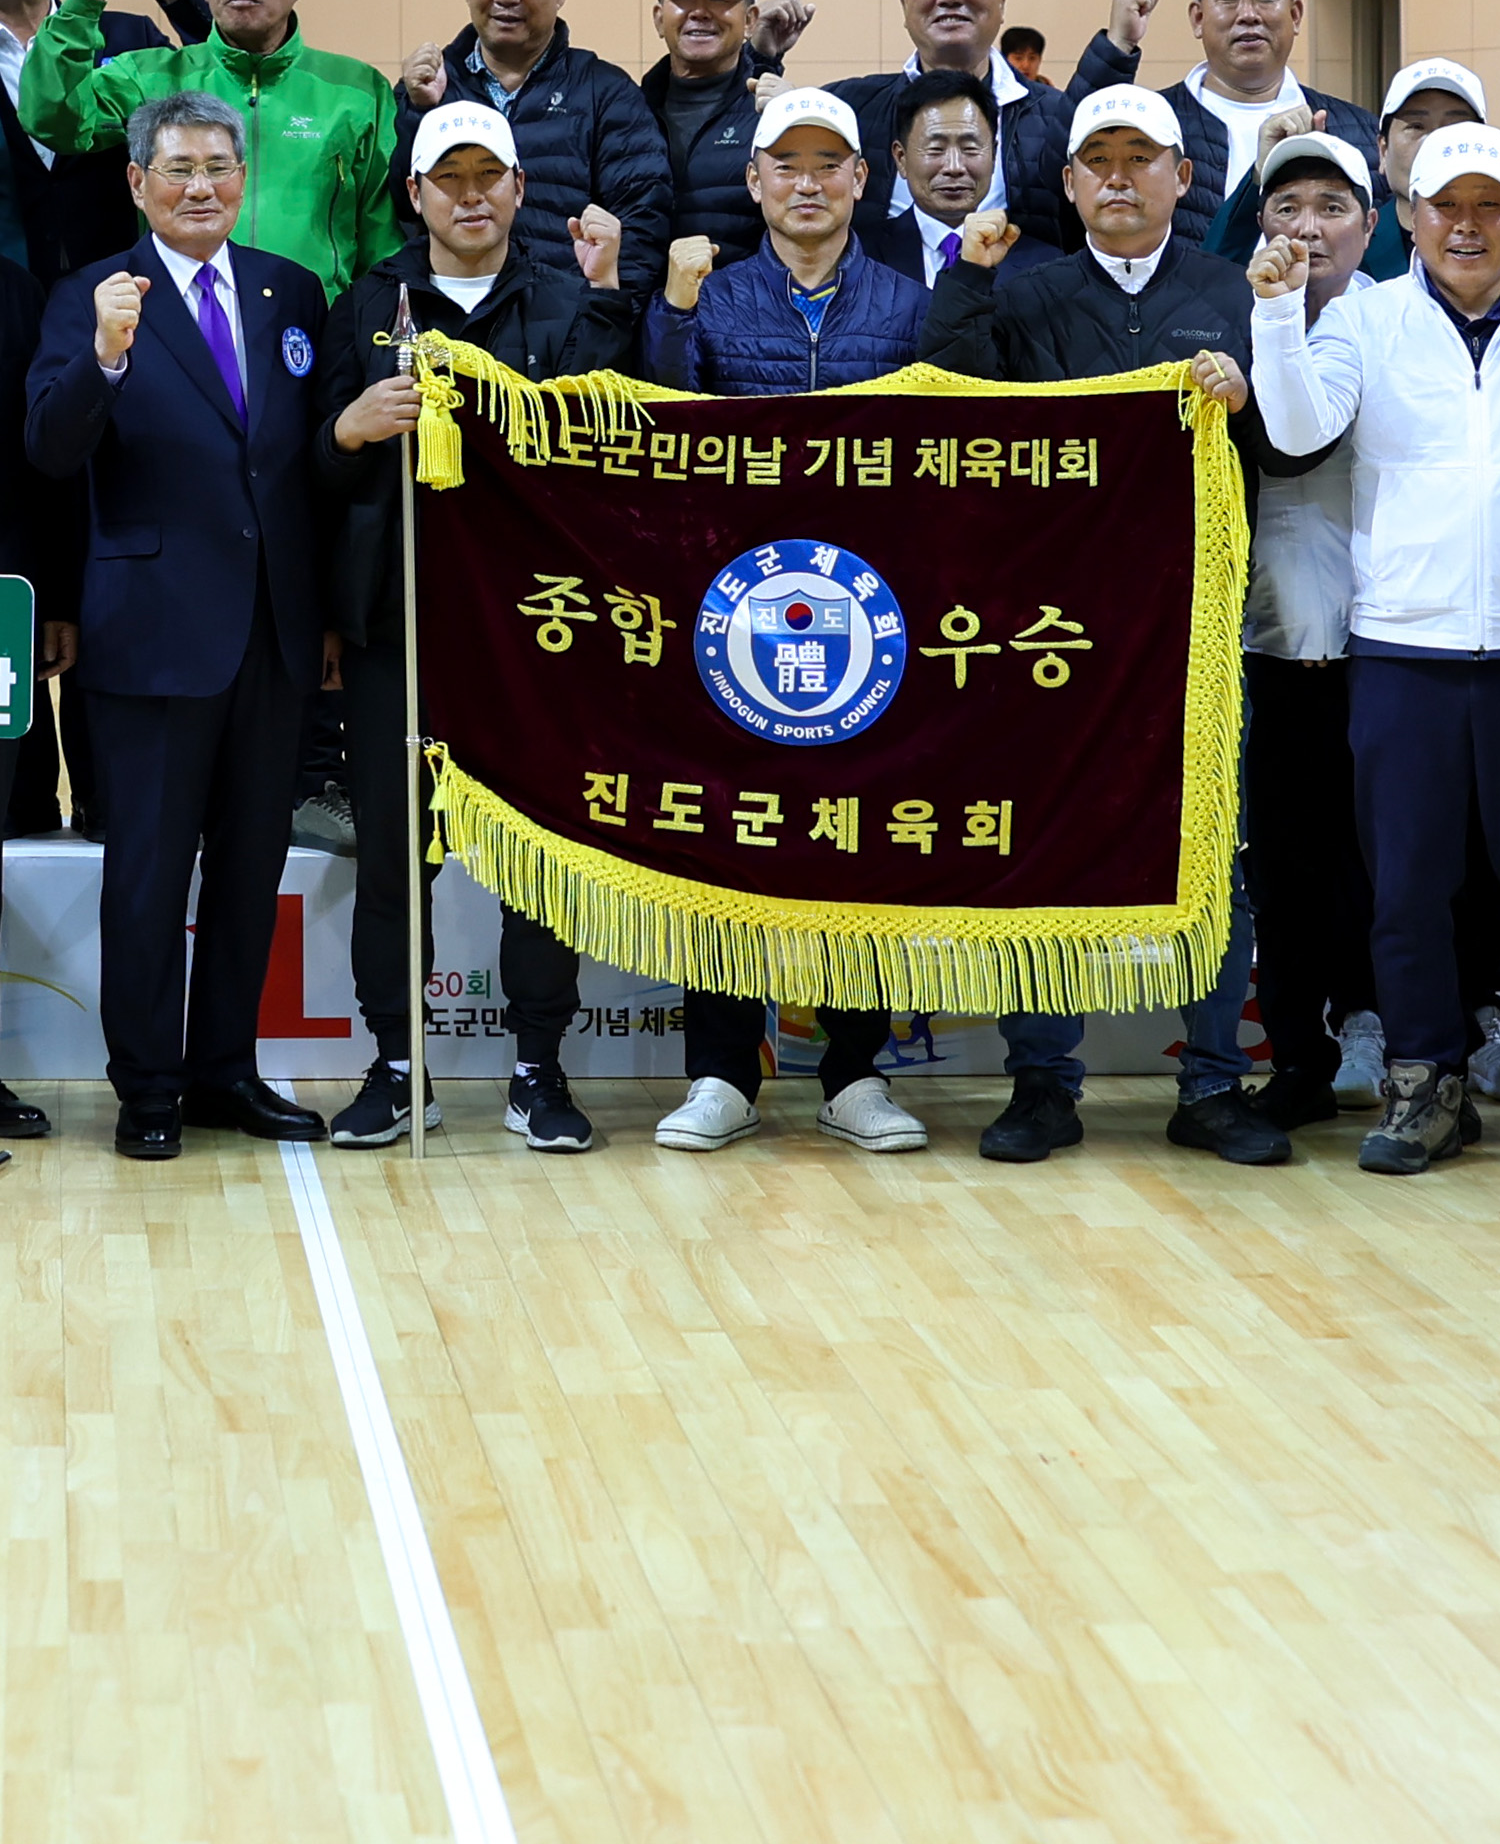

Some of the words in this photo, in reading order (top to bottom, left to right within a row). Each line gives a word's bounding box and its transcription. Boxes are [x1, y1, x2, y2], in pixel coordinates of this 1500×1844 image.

[804, 437, 892, 487] 기념
[913, 438, 1098, 489] 체육대회
[517, 573, 678, 668] 종합
[918, 604, 1094, 690] 우승
[774, 641, 828, 693] 體
[709, 668, 769, 730] JINDOGUN
[773, 723, 834, 739] SPORTS
[840, 678, 892, 730] COUNCIL
[582, 771, 1013, 856] 진도군체육회
[578, 1007, 630, 1037] 기념
